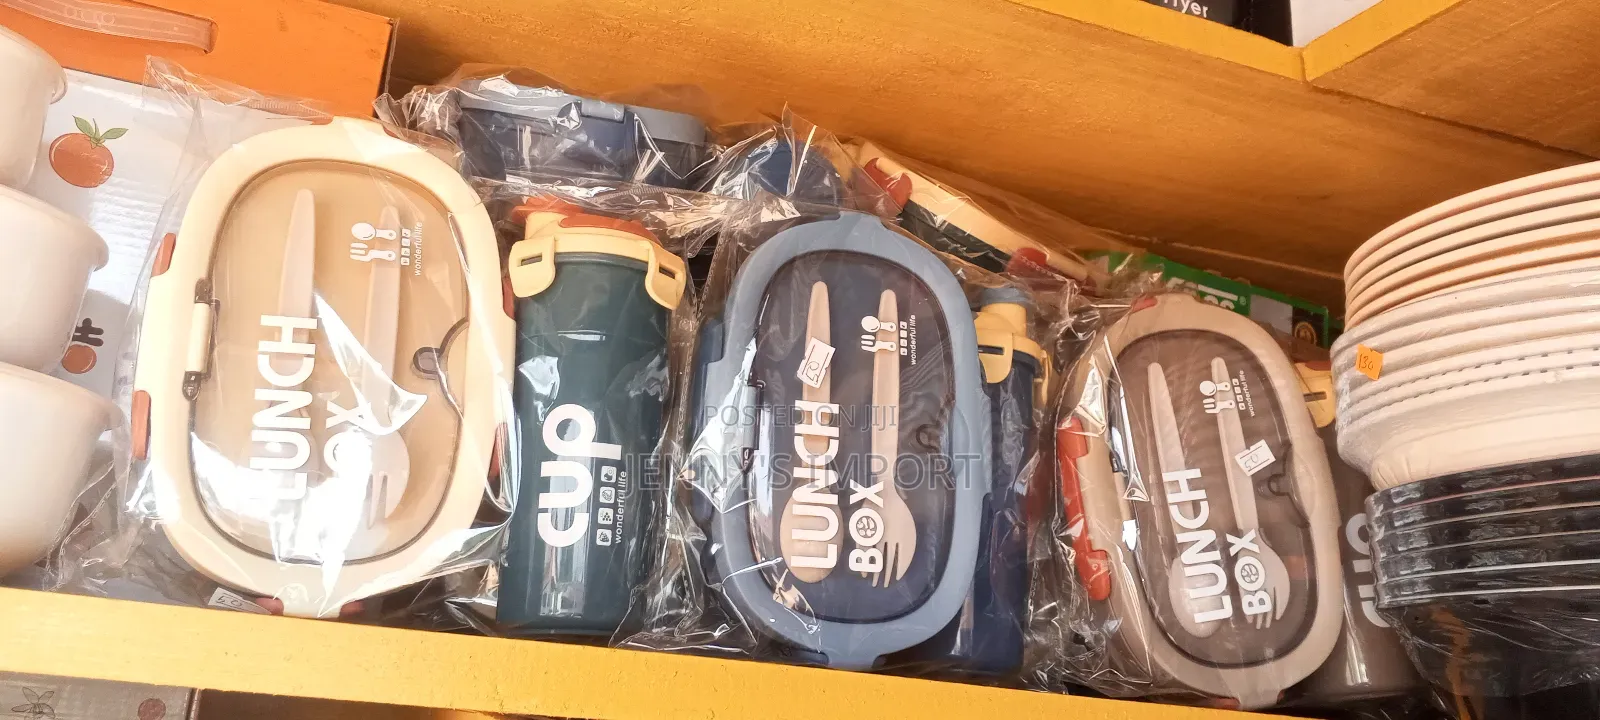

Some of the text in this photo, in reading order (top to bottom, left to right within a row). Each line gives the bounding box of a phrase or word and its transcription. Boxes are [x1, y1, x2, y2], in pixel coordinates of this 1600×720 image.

[1163, 0, 1208, 18] yer
[909, 328, 917, 365] wonderful
[250, 315, 318, 500] LUNCH
[1241, 382, 1255, 417] wonderful
[537, 403, 622, 547] cup
[615, 470, 627, 544] wonderful life
[791, 399, 840, 569] LUNCH
[849, 479, 885, 573] BOX
[1162, 468, 1233, 624] LUNCH
[1226, 528, 1273, 616] BOX
